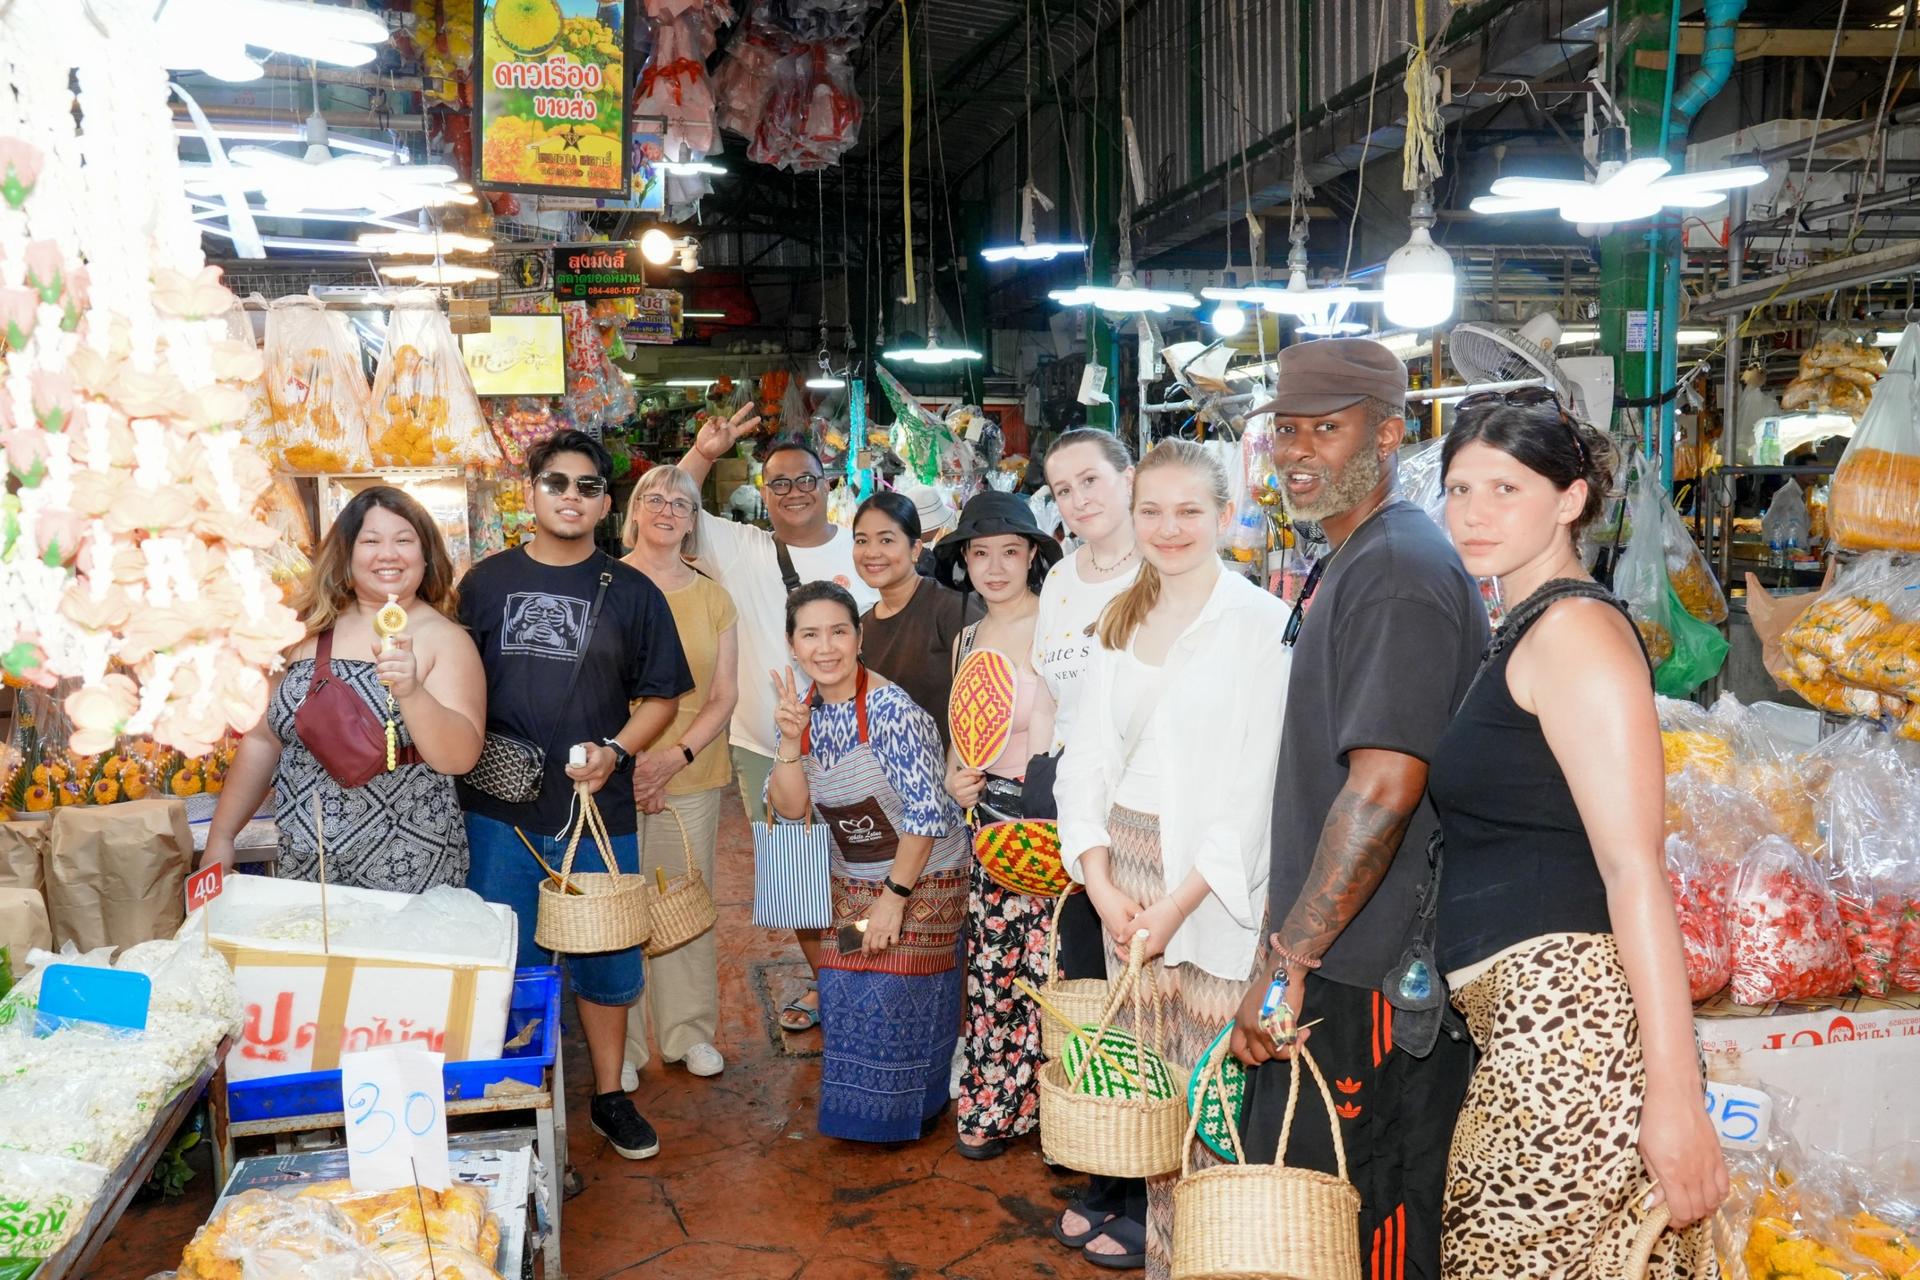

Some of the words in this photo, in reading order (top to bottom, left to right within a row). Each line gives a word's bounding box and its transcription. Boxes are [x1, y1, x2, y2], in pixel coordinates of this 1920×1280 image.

[494, 56, 600, 88] ดาวเรือง
[536, 93, 597, 119] ขายส่ง
[588, 286, 641, 295] 084-480-1577
[1054, 669, 1079, 681] NEW
[347, 1081, 437, 1155] 30
